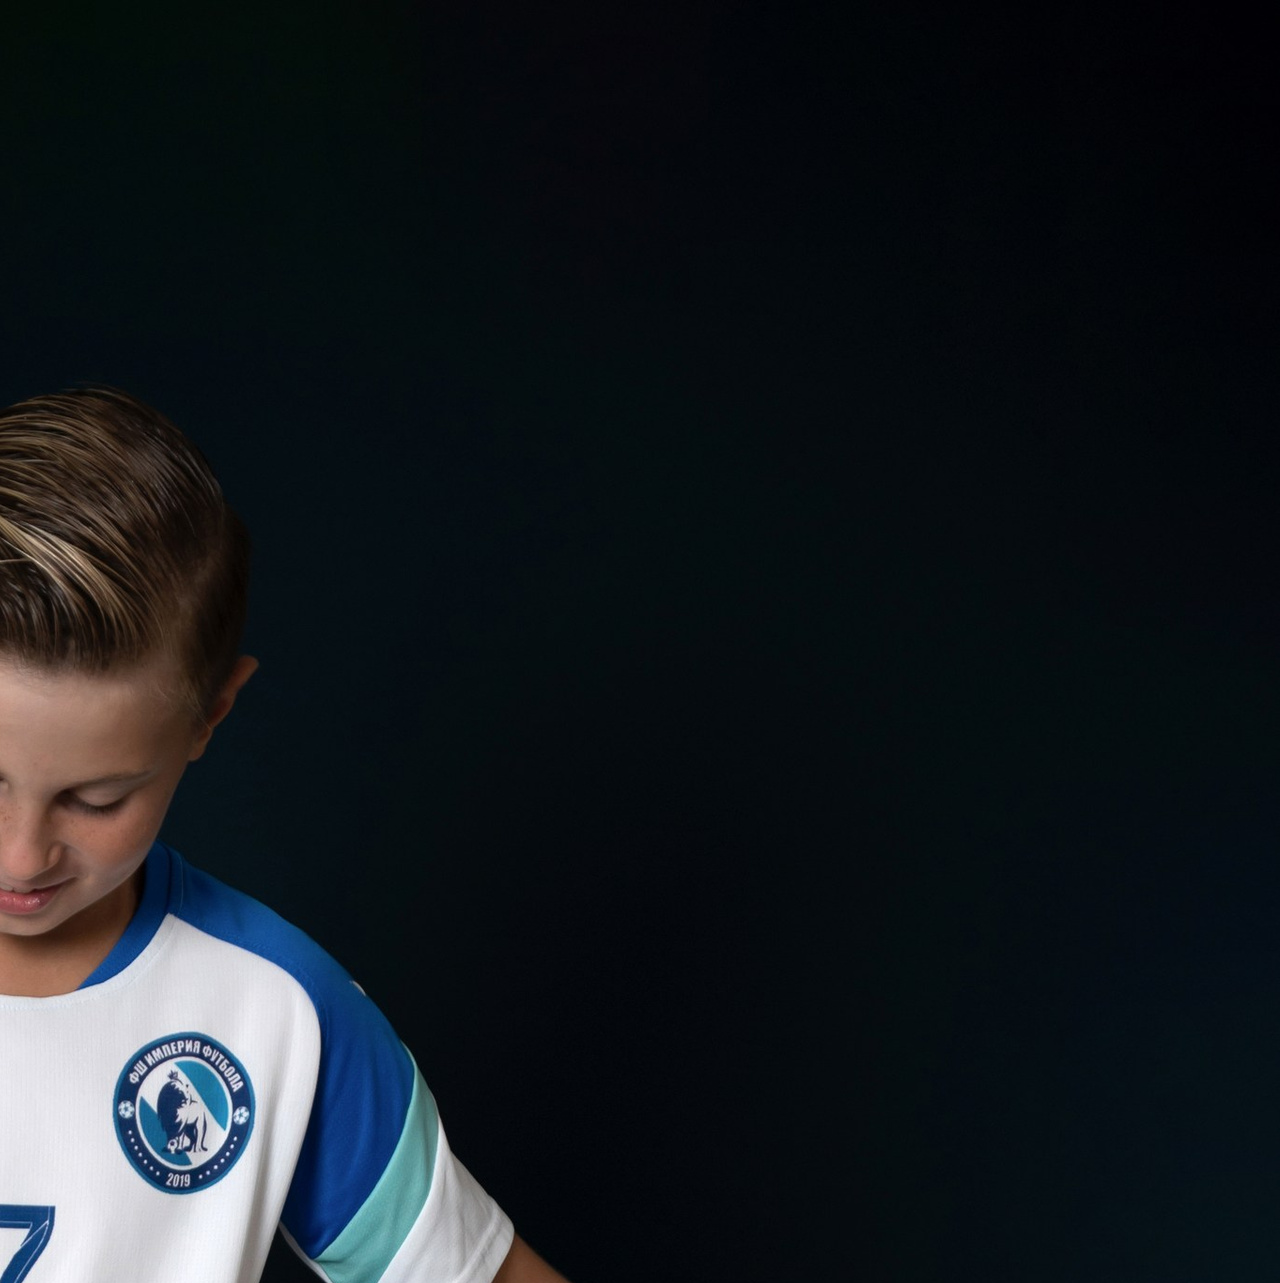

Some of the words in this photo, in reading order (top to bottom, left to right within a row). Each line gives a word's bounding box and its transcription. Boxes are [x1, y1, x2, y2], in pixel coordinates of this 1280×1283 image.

[128, 1061, 148, 1085] ФШ
[146, 1039, 201, 1066] ИМПЕРИЯ
[202, 1044, 245, 1093] ФУТБОЛА
[166, 1173, 191, 1188] 2019
